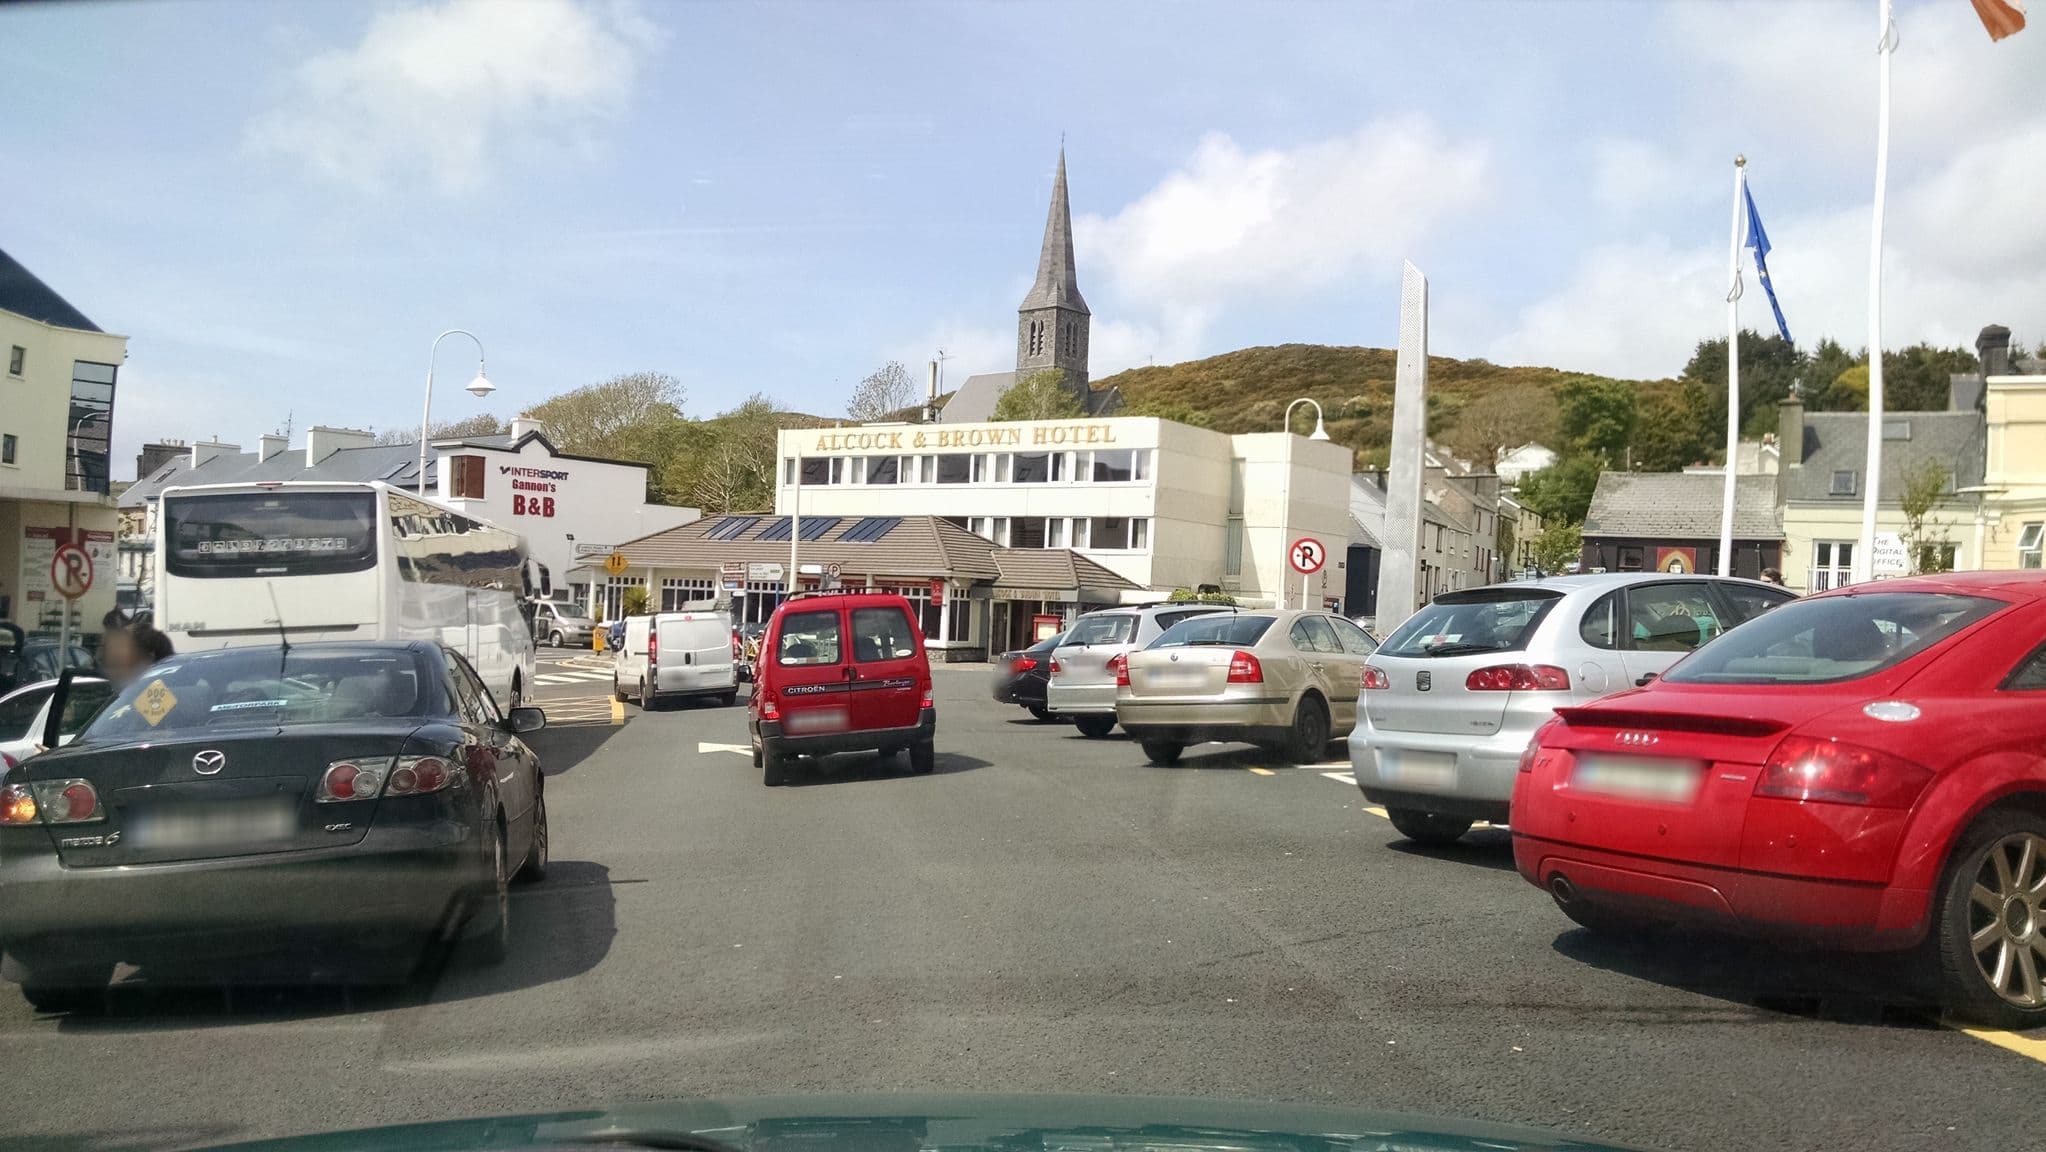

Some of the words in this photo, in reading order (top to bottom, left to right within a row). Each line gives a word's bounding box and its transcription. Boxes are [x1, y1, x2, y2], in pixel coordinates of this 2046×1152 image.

[816, 432, 903, 451] ALCOCK
[912, 431, 927, 448] &
[937, 427, 1020, 448] BROWN
[1032, 425, 1117, 444] HOTEL
[511, 467, 569, 480] INTERSPORT
[512, 479, 556, 492] Gannon's
[1302, 546, 1313, 567] P
